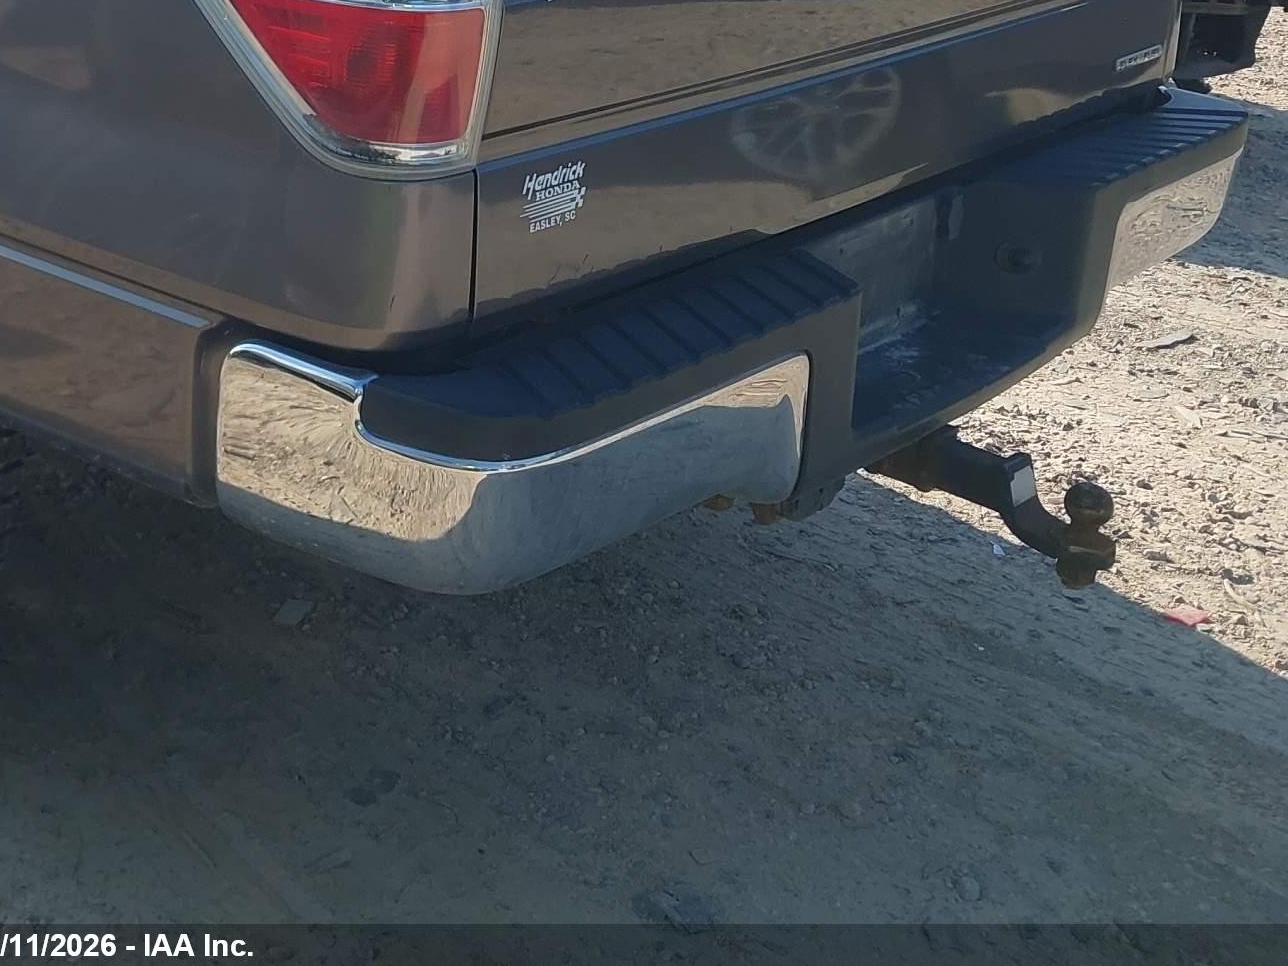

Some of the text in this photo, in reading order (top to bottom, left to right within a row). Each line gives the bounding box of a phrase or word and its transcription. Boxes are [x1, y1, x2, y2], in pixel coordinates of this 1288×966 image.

[522, 161, 586, 200] Hendrick
[535, 180, 580, 201] HONDA
[529, 210, 577, 233] EASLEY, SC
